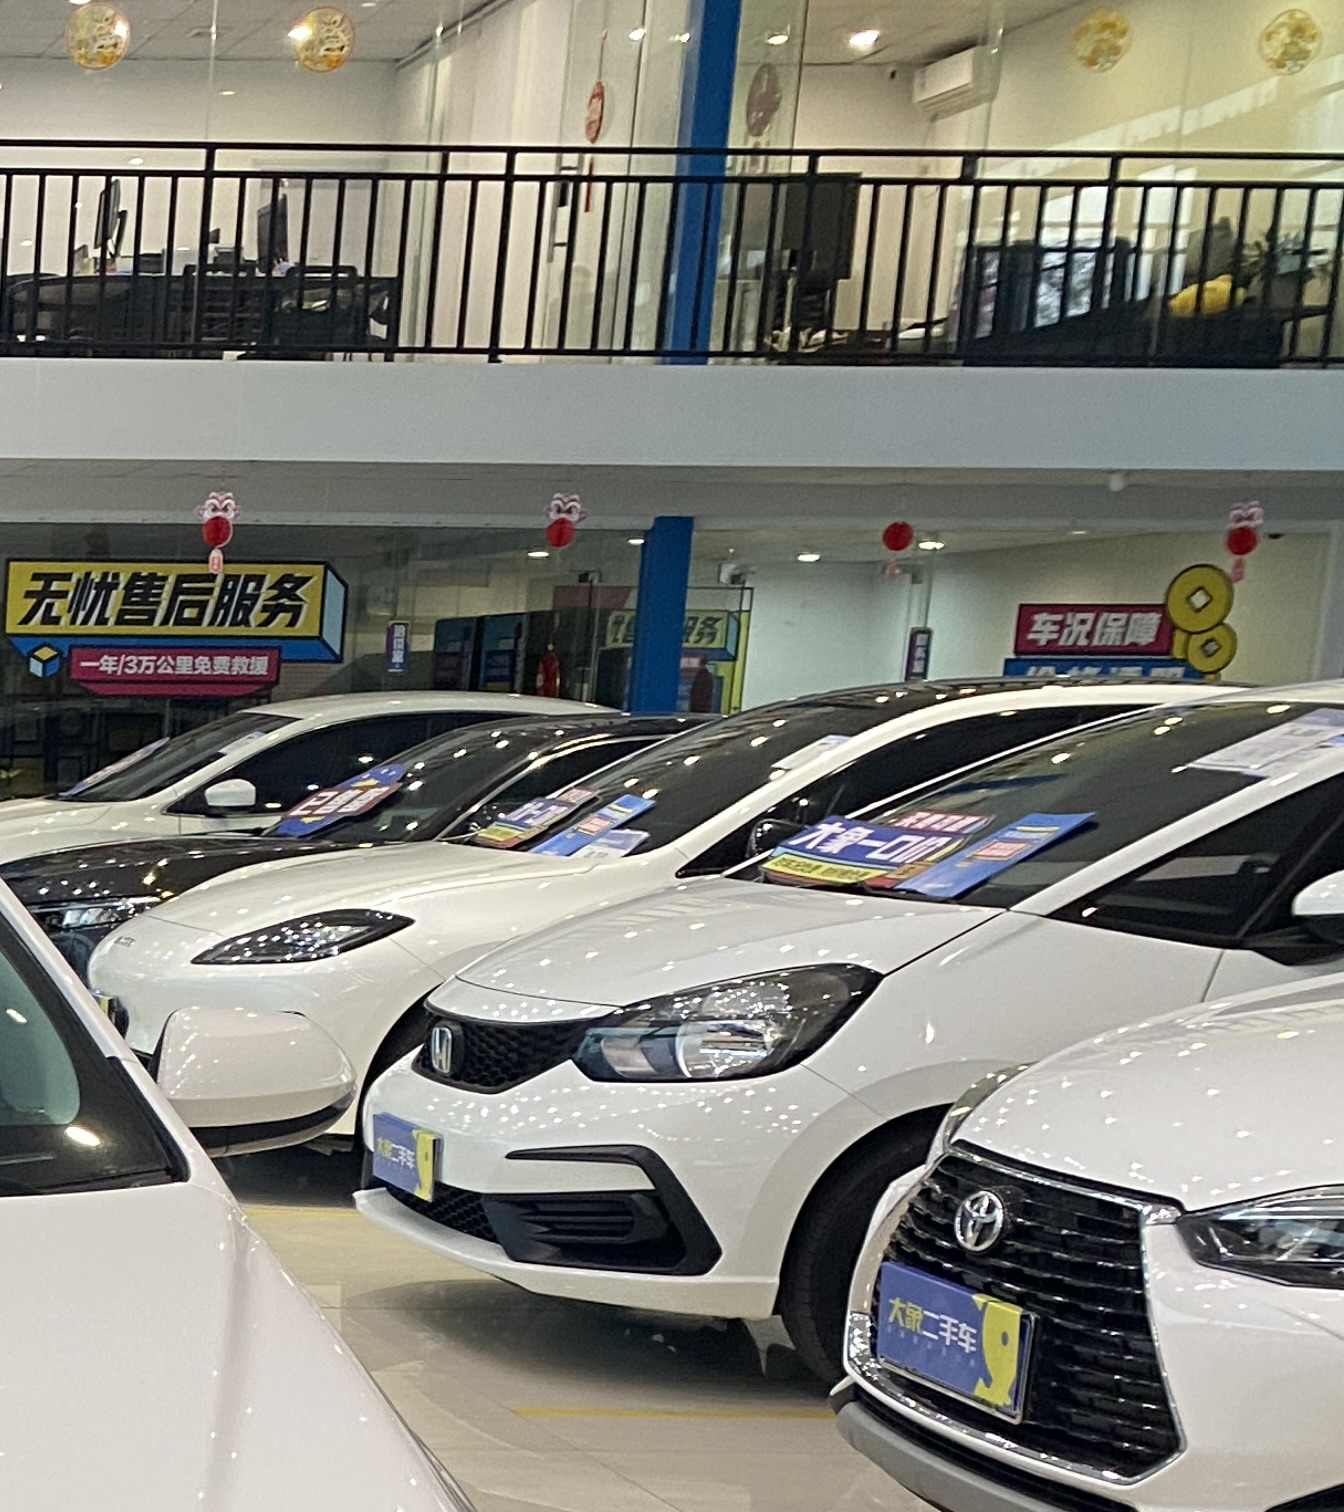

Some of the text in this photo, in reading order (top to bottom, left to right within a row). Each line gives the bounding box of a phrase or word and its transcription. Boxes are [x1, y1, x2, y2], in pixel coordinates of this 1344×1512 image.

[17, 570, 314, 628] 无忧售后服务
[1026, 612, 1162, 647] 车况保障
[80, 654, 269, 678] 一年/3万公里免费救援
[888, 1297, 978, 1354] 大象二手车
